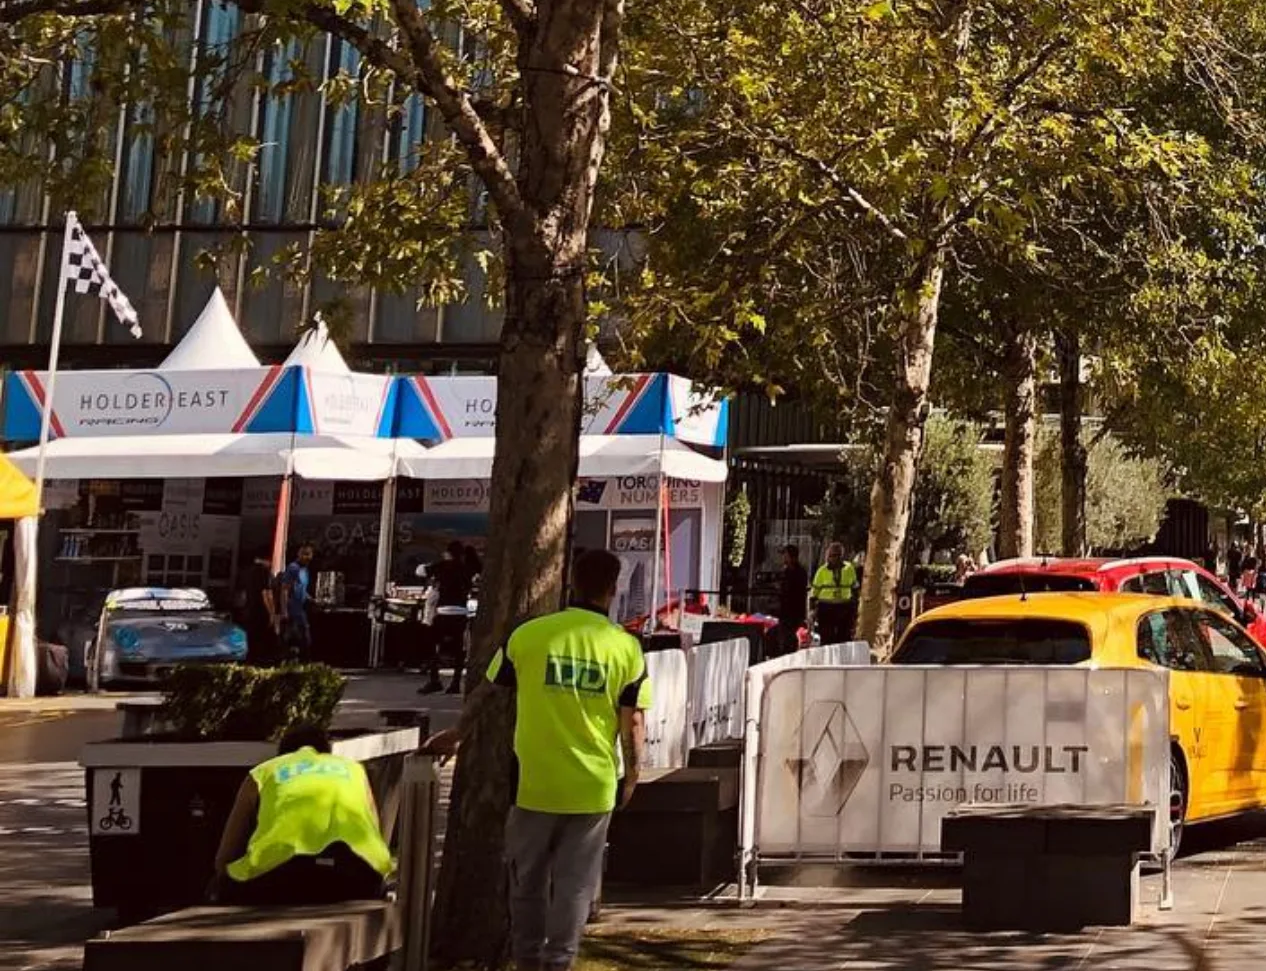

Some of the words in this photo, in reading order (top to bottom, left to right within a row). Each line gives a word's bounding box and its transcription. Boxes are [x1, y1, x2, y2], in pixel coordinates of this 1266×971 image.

[79, 391, 167, 411] HOLDER
[177, 389, 230, 408] EAST
[620, 488, 699, 505] NUMERS
[890, 744, 1089, 774] RENAULT
[889, 782, 967, 803] Passion
[973, 782, 1004, 803] for
[1007, 782, 1039, 803] life
